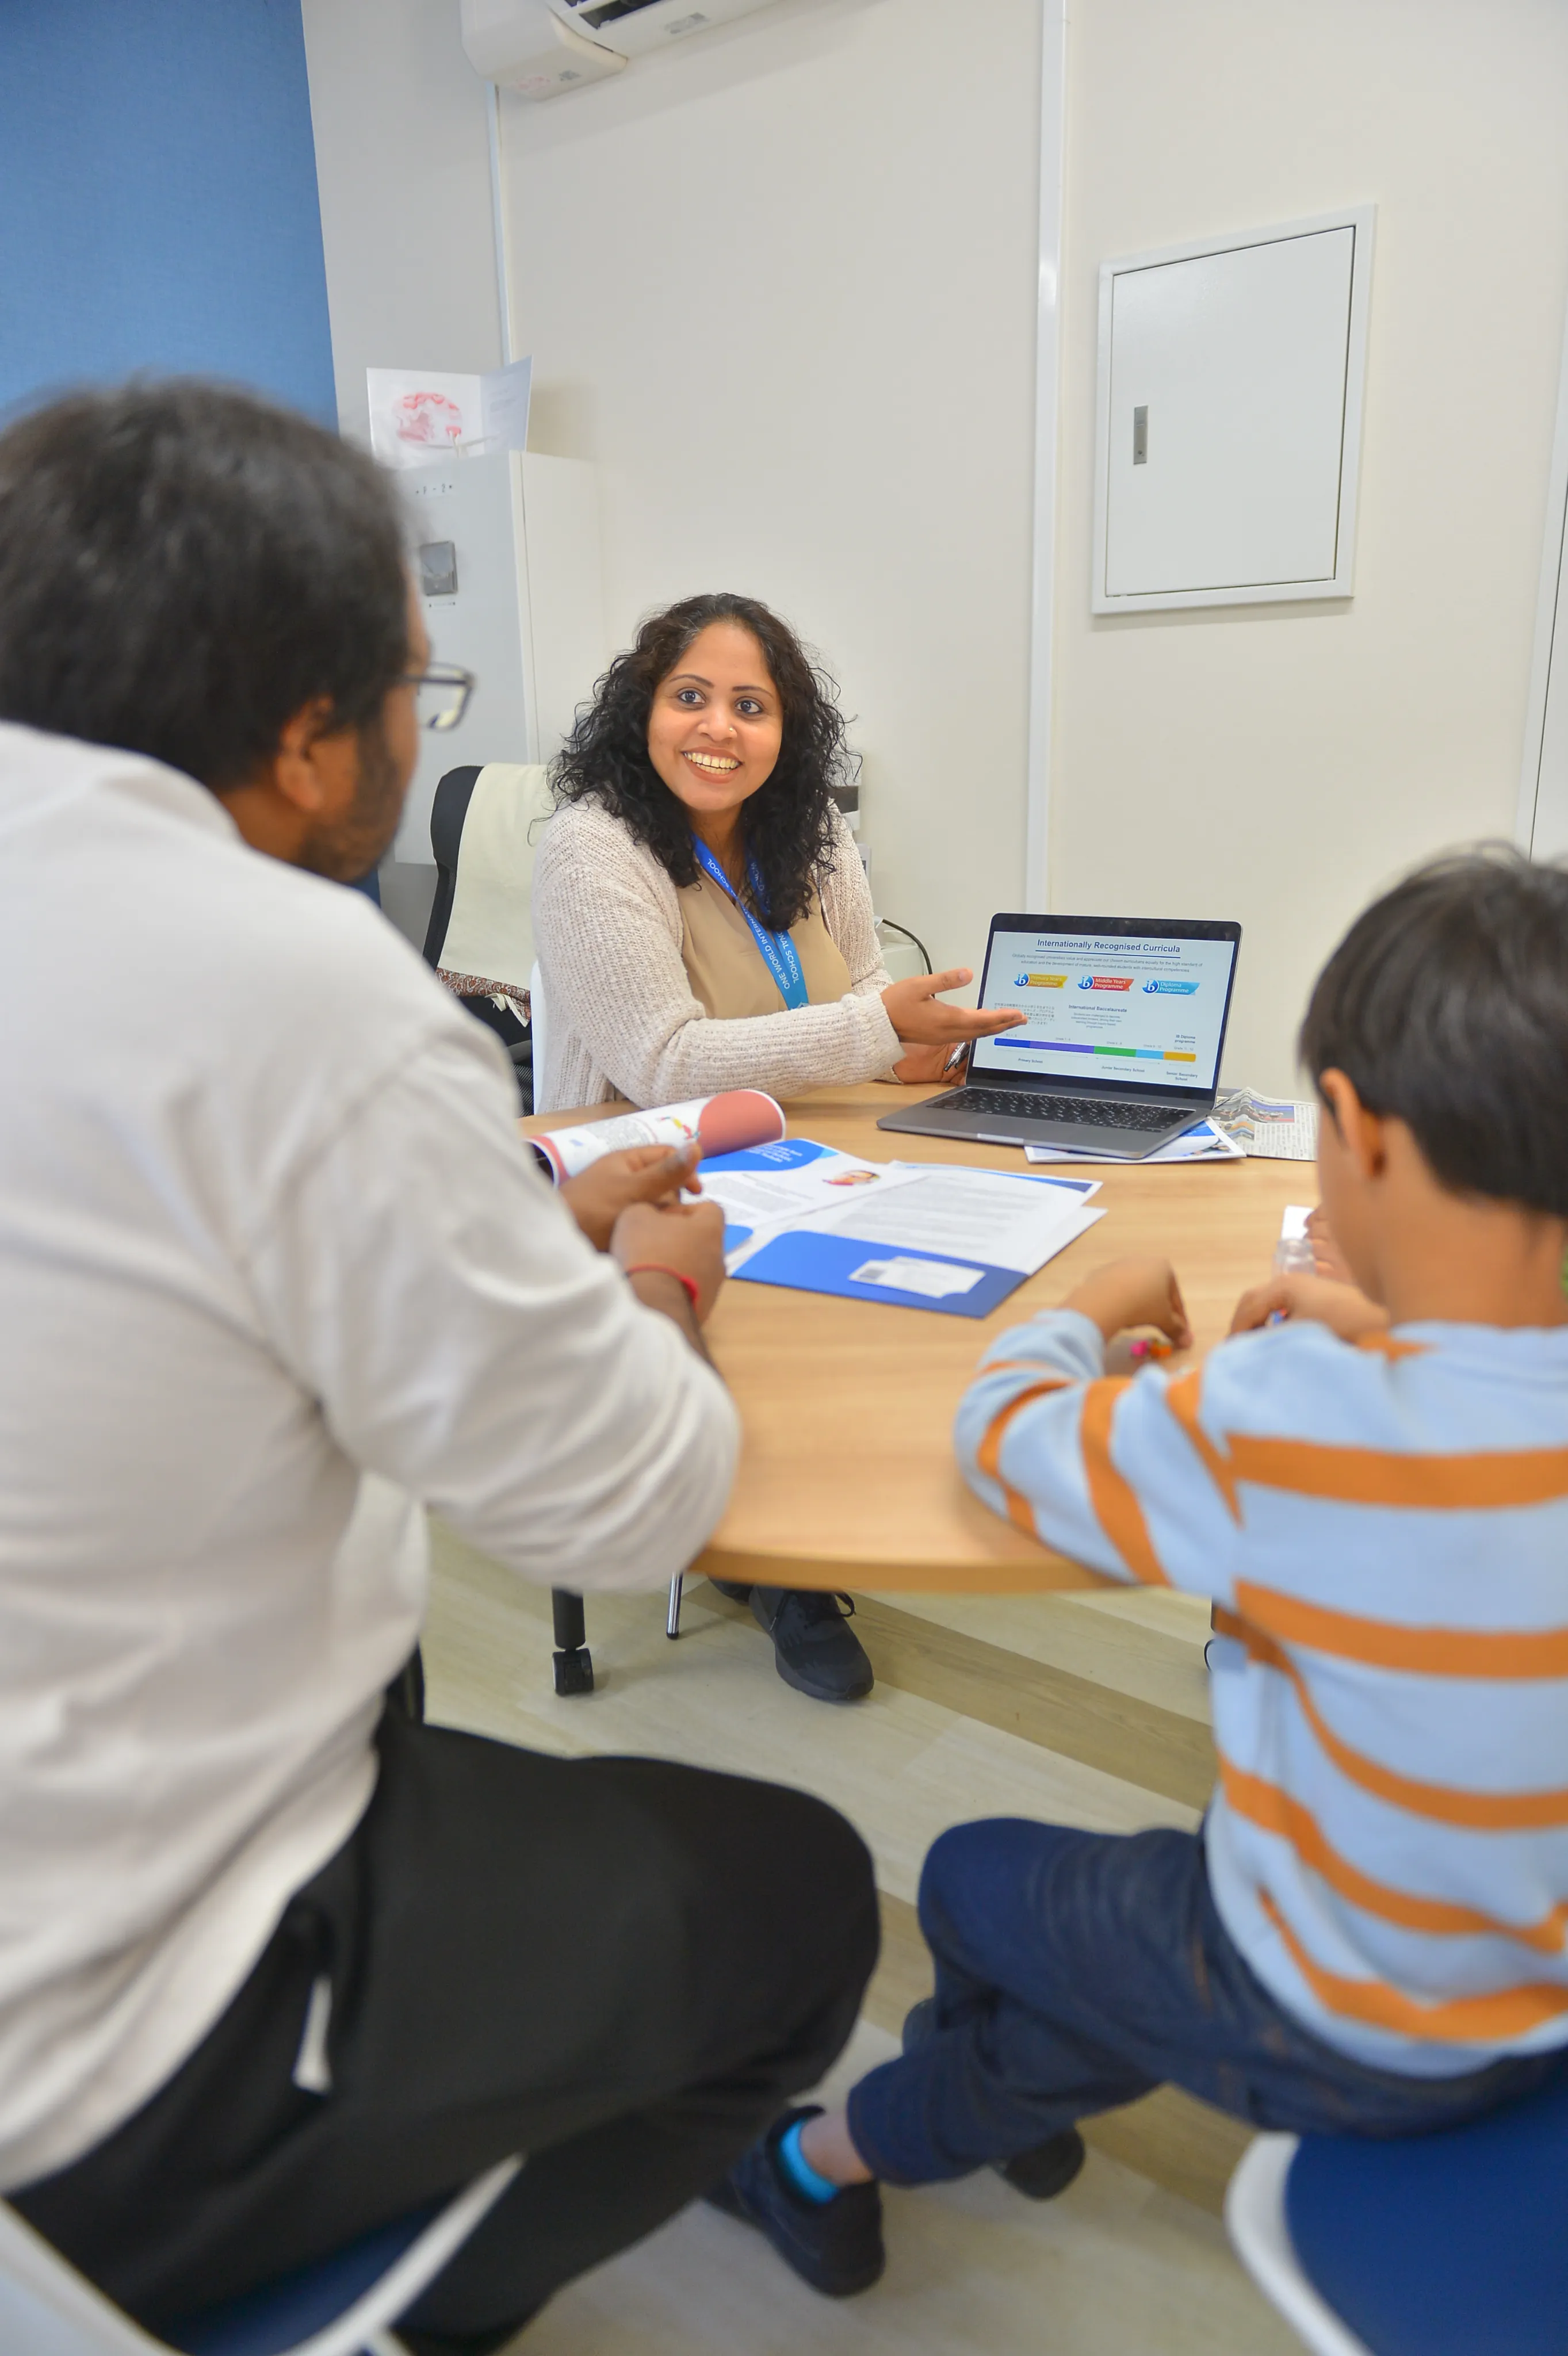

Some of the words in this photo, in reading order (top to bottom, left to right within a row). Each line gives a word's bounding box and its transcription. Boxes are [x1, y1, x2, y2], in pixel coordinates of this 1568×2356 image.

[706, 858, 730, 888] SCHOOL
[764, 945, 782, 973] WORLD
[1037, 939, 1092, 950] Internationally
[1094, 942, 1141, 952] Recognised
[1143, 944, 1180, 953] Curricula
[778, 972, 790, 989] ONE
[785, 950, 800, 984] SCHOOL
